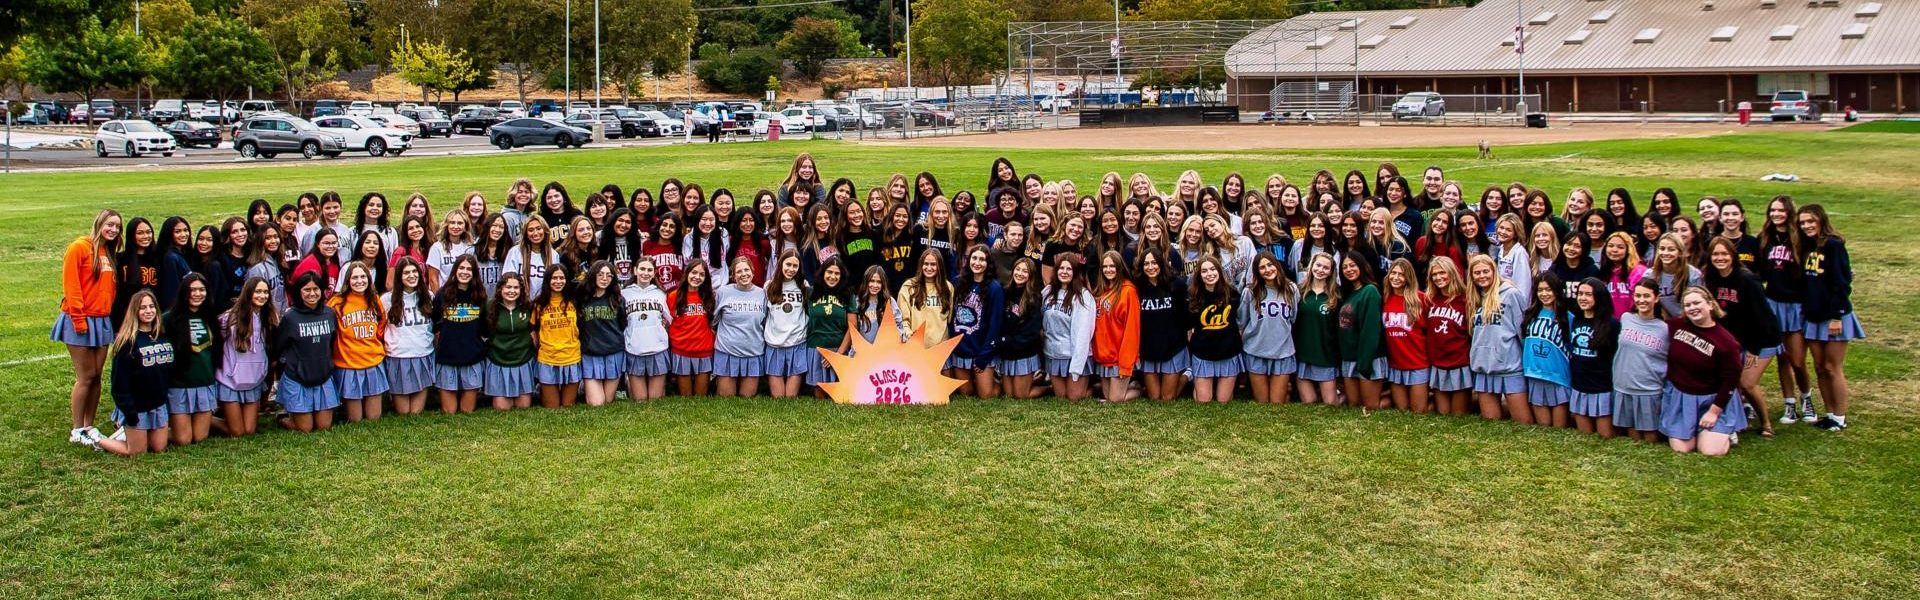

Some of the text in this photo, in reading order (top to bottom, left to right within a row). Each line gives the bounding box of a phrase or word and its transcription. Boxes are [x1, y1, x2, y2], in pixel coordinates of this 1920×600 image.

[727, 302, 766, 312] PORTLAN
[781, 292, 804, 303] CSB
[1139, 296, 1172, 311] YALE
[396, 307, 431, 327] CL
[1200, 303, 1232, 330] Cal
[1257, 301, 1293, 320] TCU
[1428, 306, 1465, 327] LABAMA
[353, 325, 375, 339] VOLS
[1623, 327, 1664, 352] TANFORD
[899, 373, 913, 386] OF
[875, 386, 912, 405] 2026
